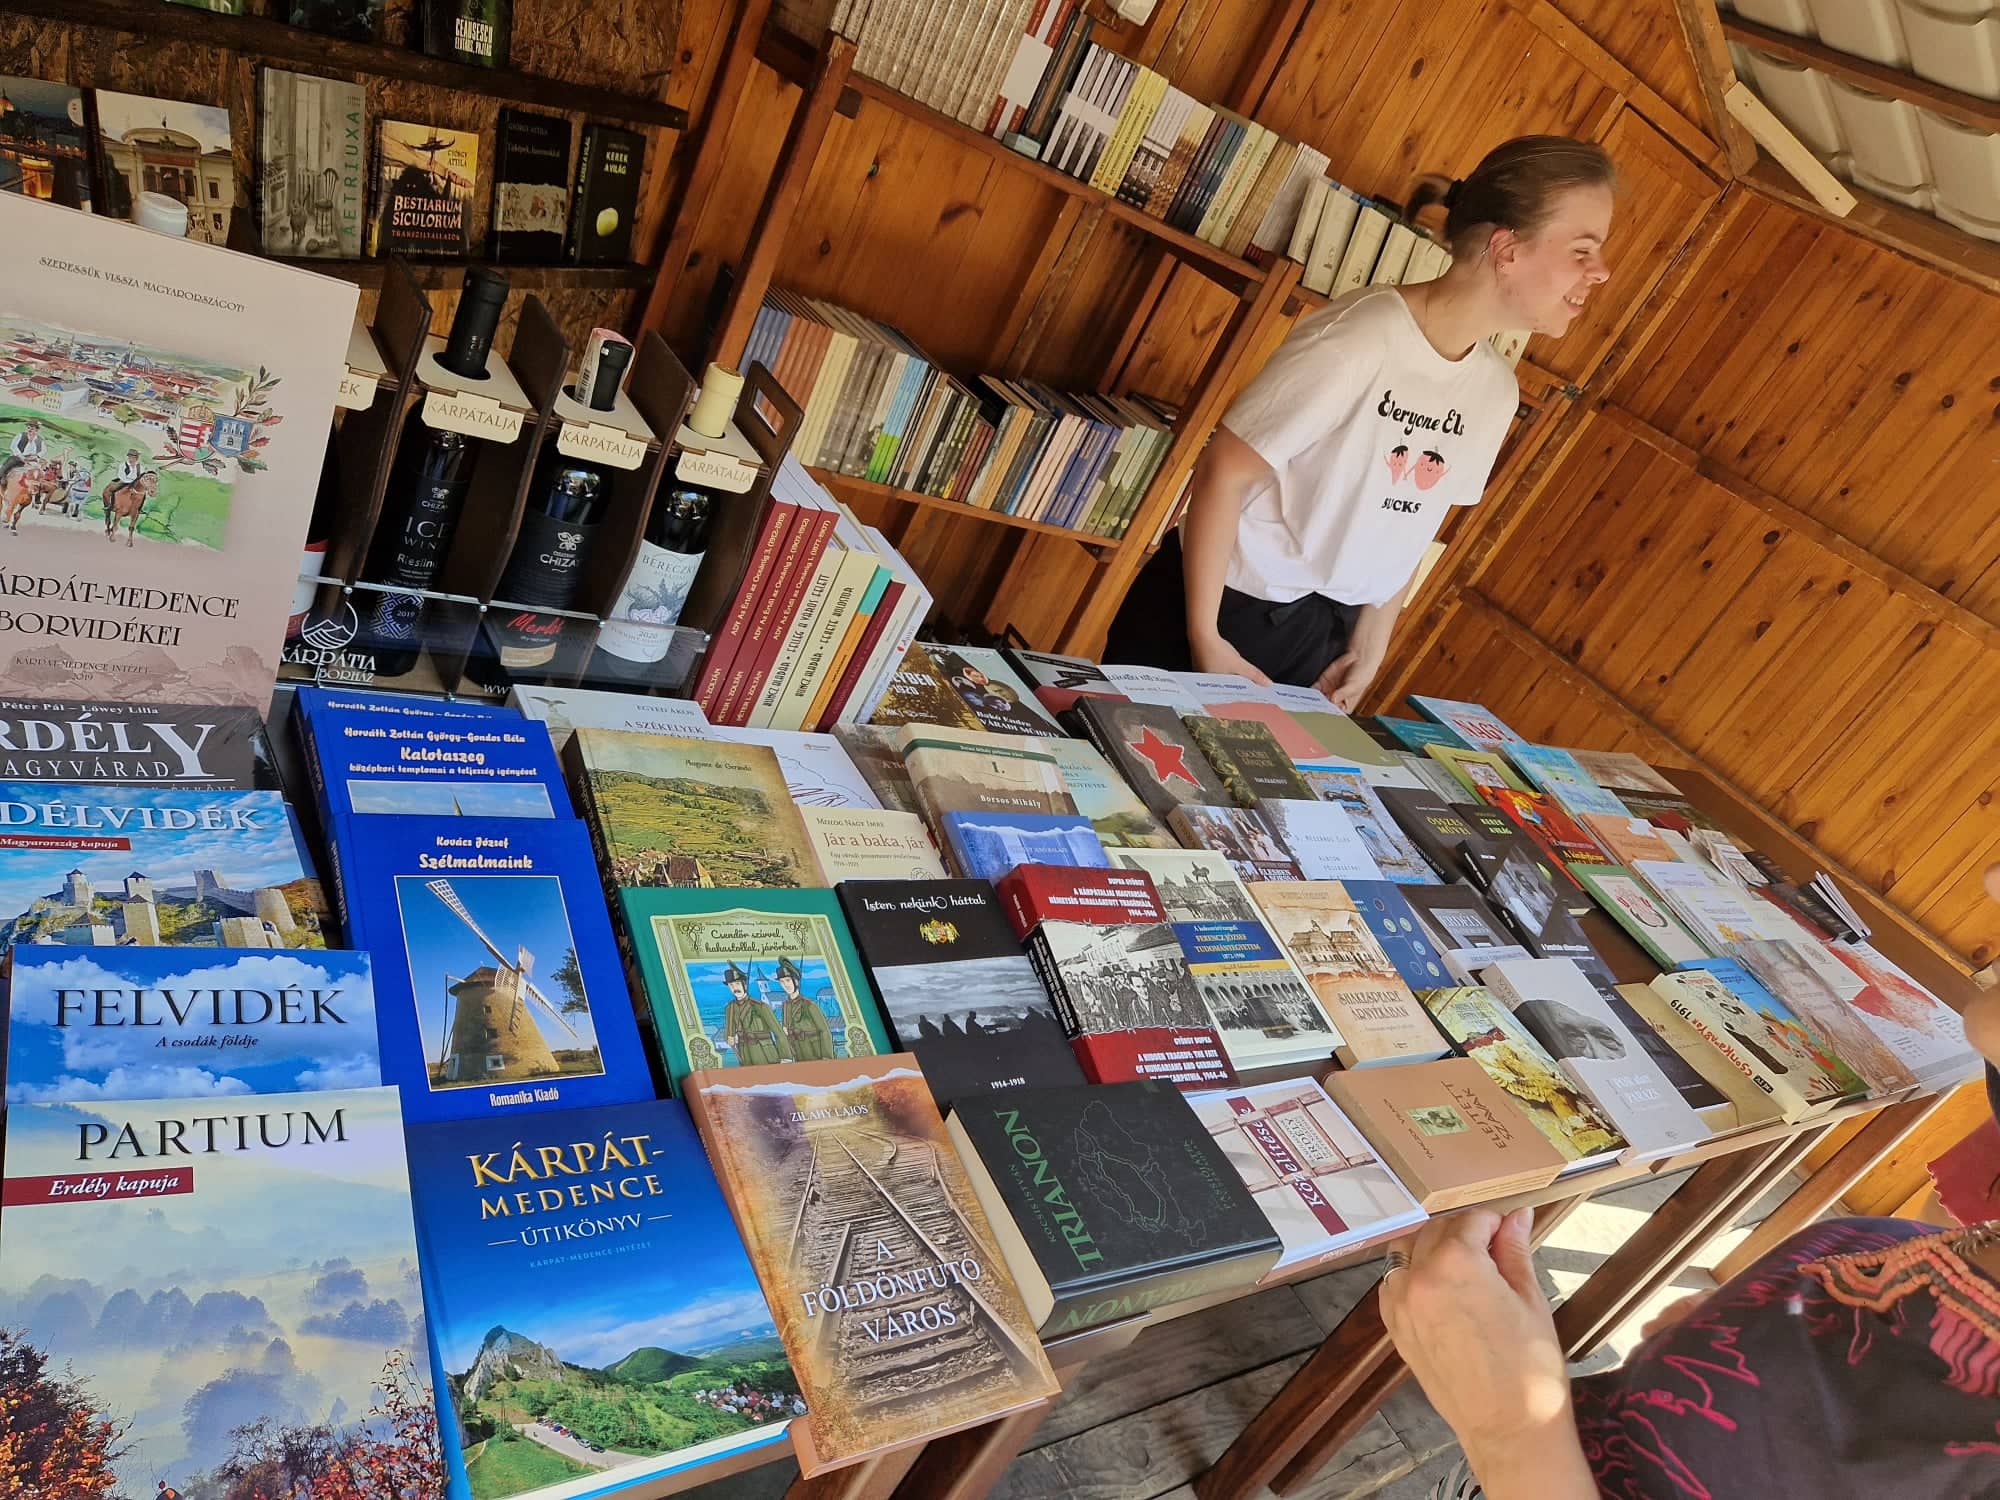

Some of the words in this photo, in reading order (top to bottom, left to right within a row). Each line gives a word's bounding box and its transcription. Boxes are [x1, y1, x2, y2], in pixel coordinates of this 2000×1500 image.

[393, 195, 463, 214] BESTIARIUM
[392, 212, 462, 229] SICULORUM
[39, 256, 101, 279] SZERESSÜK
[105, 272, 140, 288] VISSZA
[143, 280, 245, 313] MAGYARORSZÁGOT!
[428, 400, 519, 431] KÁRPÁTALJA
[1378, 389, 1440, 436] Everyone
[562, 424, 641, 459] KÁRPÁTALJA
[680, 458, 752, 484] KÁRPÁTALJA
[421, 499, 449, 511] CHIZA
[1382, 497, 1422, 513] SUCKS
[404, 536, 437, 550] WIN
[397, 553, 438, 568] Rieslin
[540, 554, 579, 568] CHIZA
[0, 566, 240, 620] ÁRPÁT-MEDENCE
[731, 620, 742, 635] ADY
[728, 671, 743, 696] ZOLTÁN
[753, 625, 763, 641] ADY
[748, 671, 763, 696] ZOLTÁN
[773, 625, 784, 641] ADY
[318, 668, 375, 683] BORHÁZ
[893, 685, 920, 697] 1920
[2, 702, 37, 714] Péter
[43, 703, 65, 713] Pál
[129, 706, 159, 715] Lilla
[344, 727, 387, 739] Horváth
[389, 728, 424, 741] Zoltán
[503, 732, 526, 744] Béla
[624, 721, 633, 730] A
[635, 722, 704, 735] SZÉKELYEK
[0, 714, 216, 778] RDÉLY
[400, 746, 485, 766] Kalotaszeg
[4, 759, 169, 778] AGYVÁRAD
[349, 763, 395, 774] középkori
[398, 765, 446, 776] templomai
[0, 800, 266, 832] DÉLVIDÉK
[80, 840, 119, 850] kapuja
[436, 835, 472, 848] Kovács
[475, 836, 509, 850] József
[823, 833, 846, 848] Jár
[850, 839, 859, 847] a
[863, 832, 904, 849] baka,
[907, 837, 926, 850] jár
[419, 853, 533, 871] Szélmalmaink
[862, 898, 896, 911] Isten
[900, 896, 948, 911] nekünk
[950, 894, 986, 907] háttal
[53, 984, 349, 1027] FELVIDÉK
[1671, 999, 1692, 1021] 1919
[155, 1037, 167, 1048] A
[171, 1034, 218, 1048] csodák
[220, 1034, 259, 1049] földje
[490, 1091, 532, 1107] Romanika
[534, 1087, 560, 1103] Kiadó
[790, 1106, 833, 1122] ZILAHY
[835, 1104, 869, 1119] LAJOS
[1441, 1080, 1507, 1151] ELEJTETT
[75, 1108, 349, 1160] PARTIUM
[465, 1131, 665, 1188] KÁRPÁT-
[48, 1176, 111, 1198] Erdély
[115, 1174, 180, 1196] kapuja
[993, 1108, 1104, 1272] TRIANON
[479, 1173, 665, 1220] MEDENCE
[520, 1213, 642, 1247] ÚTIKÖNYV
[875, 1239, 896, 1262] A
[800, 1252, 982, 1318] FÖLDÖNFUTÓ
[861, 1301, 958, 1344] VÁROS
